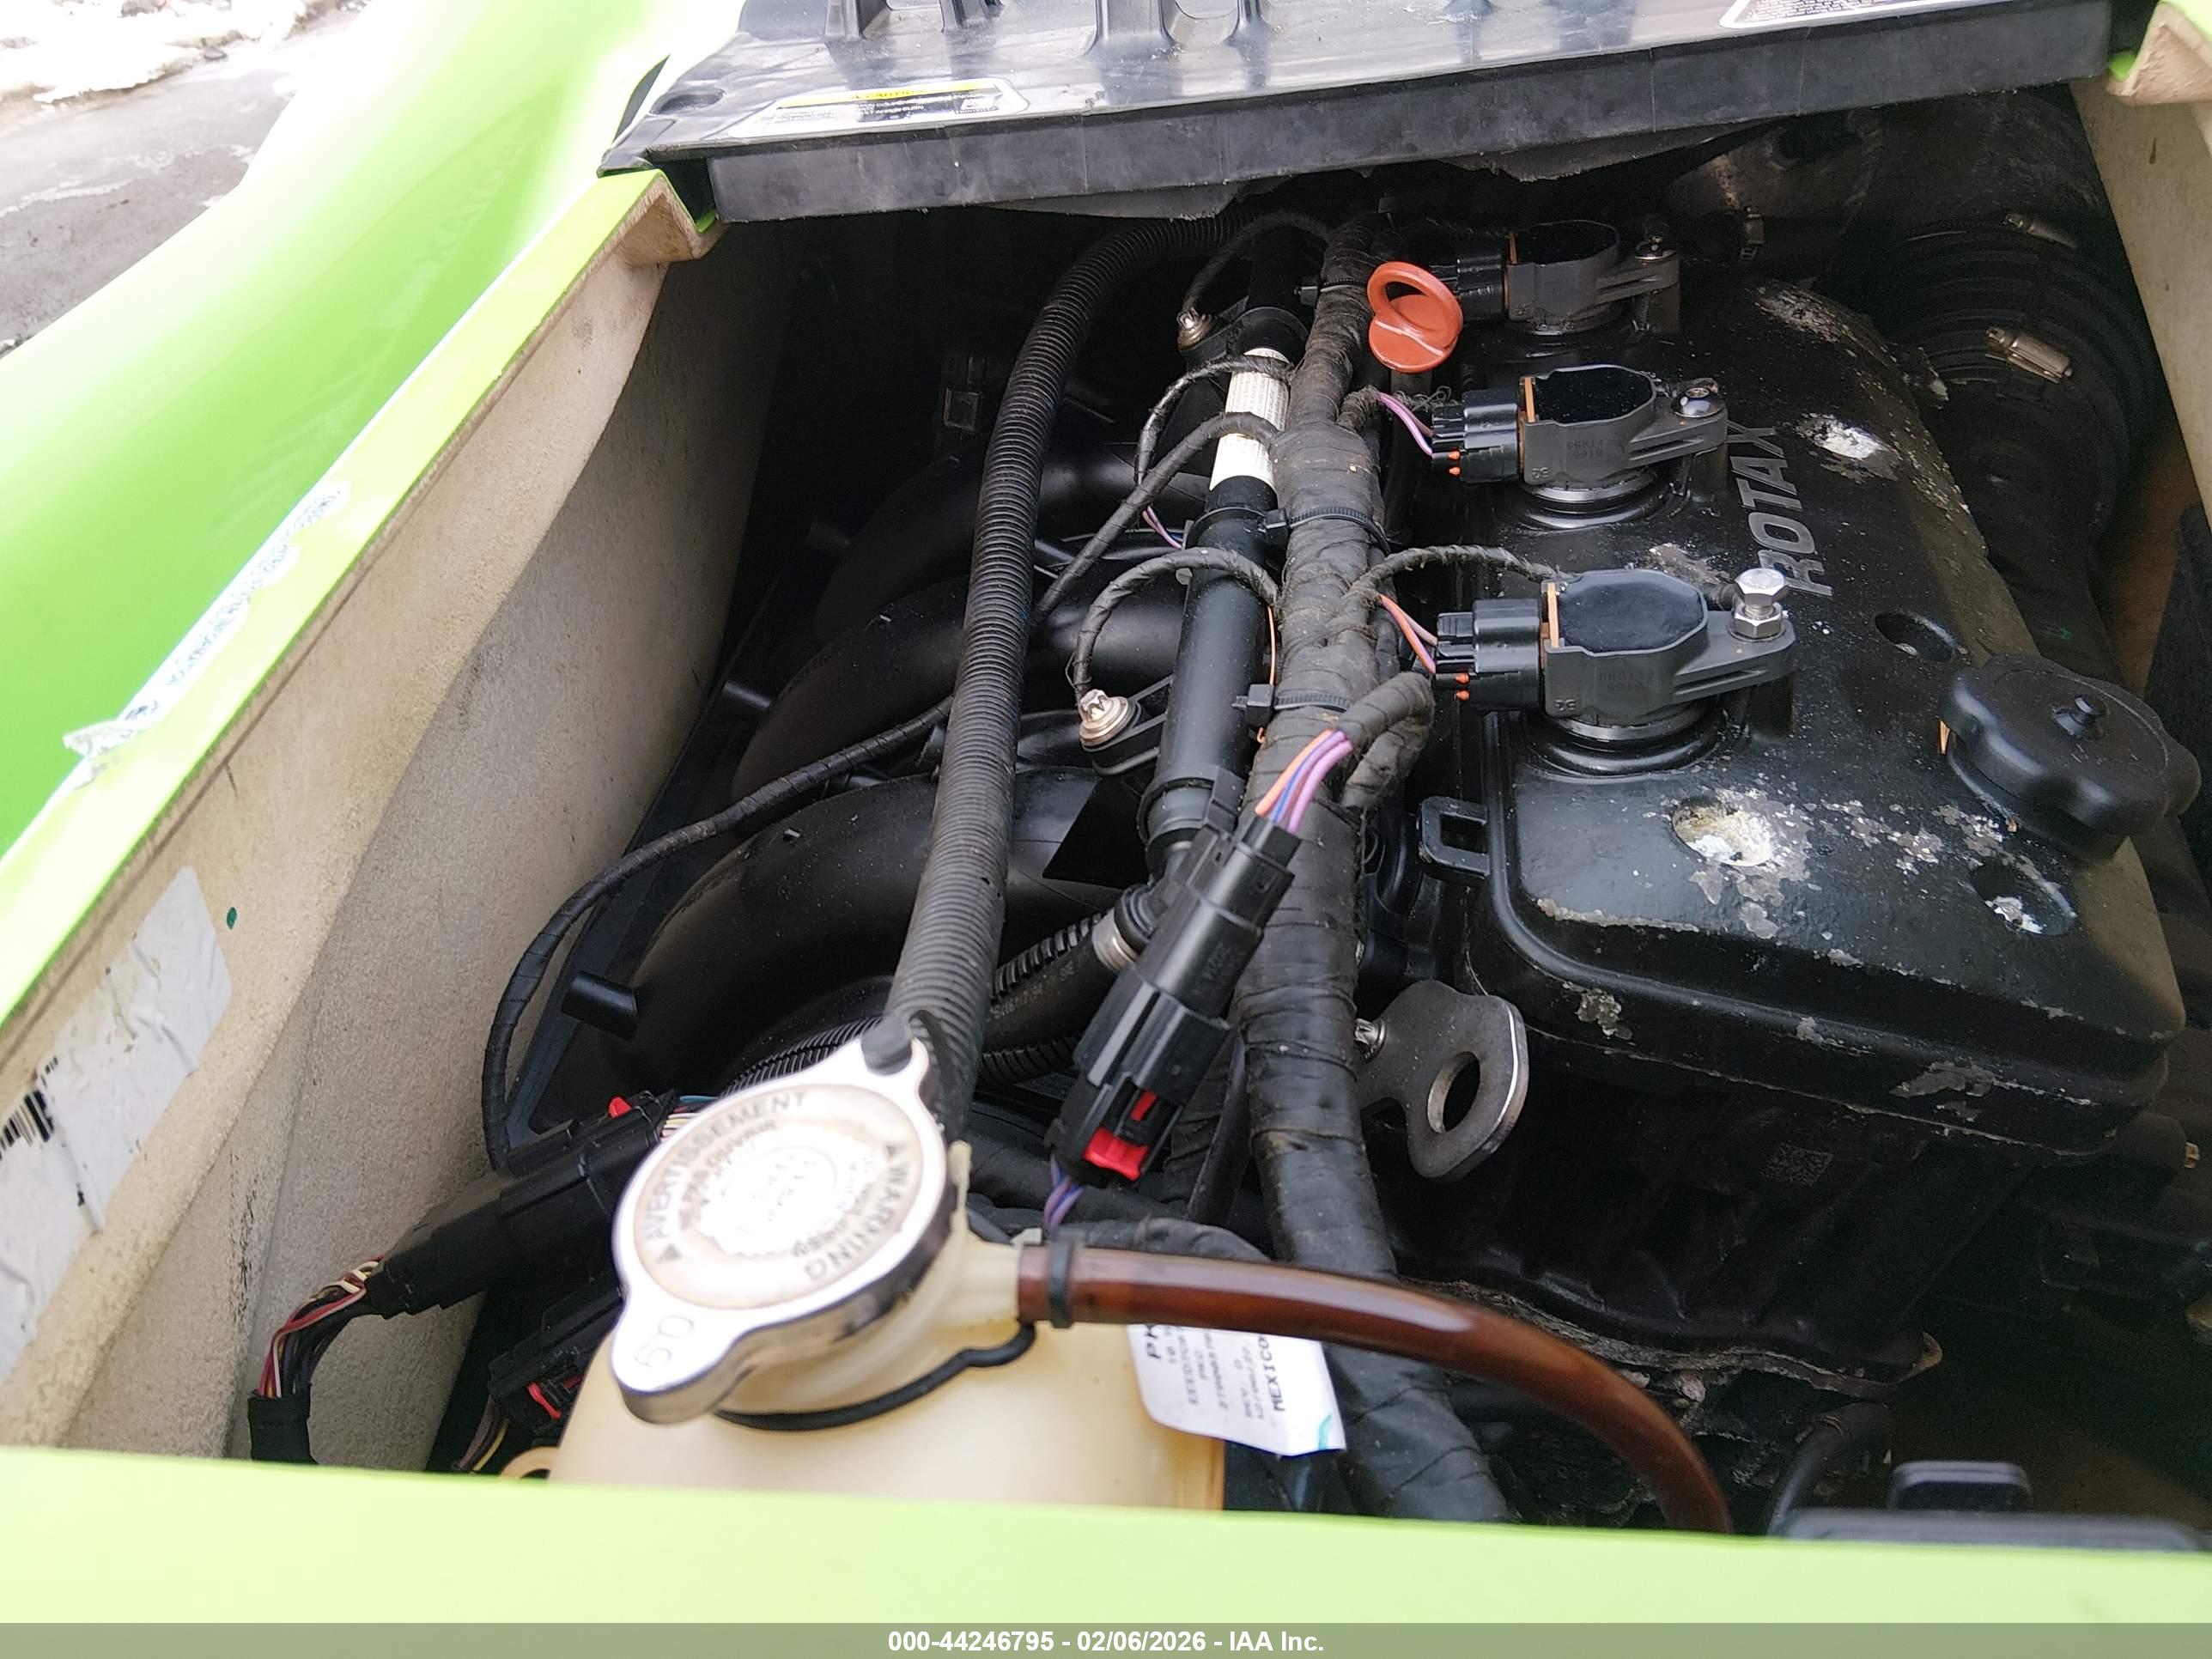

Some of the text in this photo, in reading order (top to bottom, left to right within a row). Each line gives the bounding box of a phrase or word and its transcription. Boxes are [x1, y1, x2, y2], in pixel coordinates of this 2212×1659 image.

[1726, 420, 1833, 597] ROTAX
[805, 1156, 910, 1281] WARNING
[1257, 1335, 1285, 1412] MEXICO
